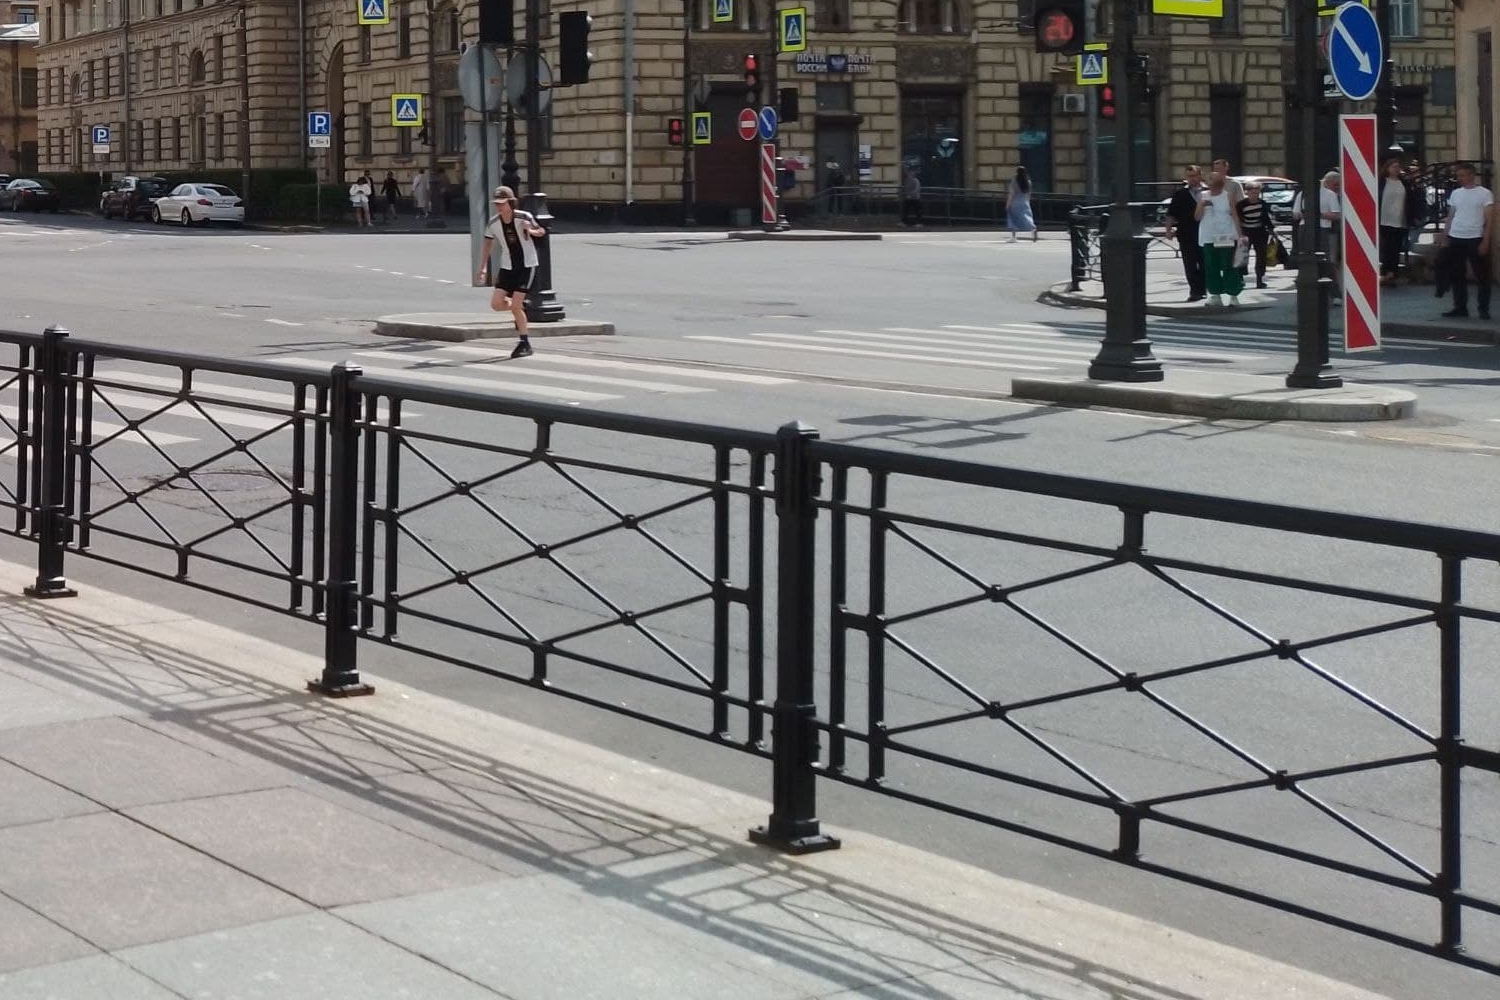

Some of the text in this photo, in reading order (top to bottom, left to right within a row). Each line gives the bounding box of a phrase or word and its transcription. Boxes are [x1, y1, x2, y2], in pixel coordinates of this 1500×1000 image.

[796, 53, 826, 63] ПОЧТА
[847, 53, 876, 64] ПОЧТА
[796, 63, 828, 73] РОССИИ
[847, 64, 871, 73] БАНК
